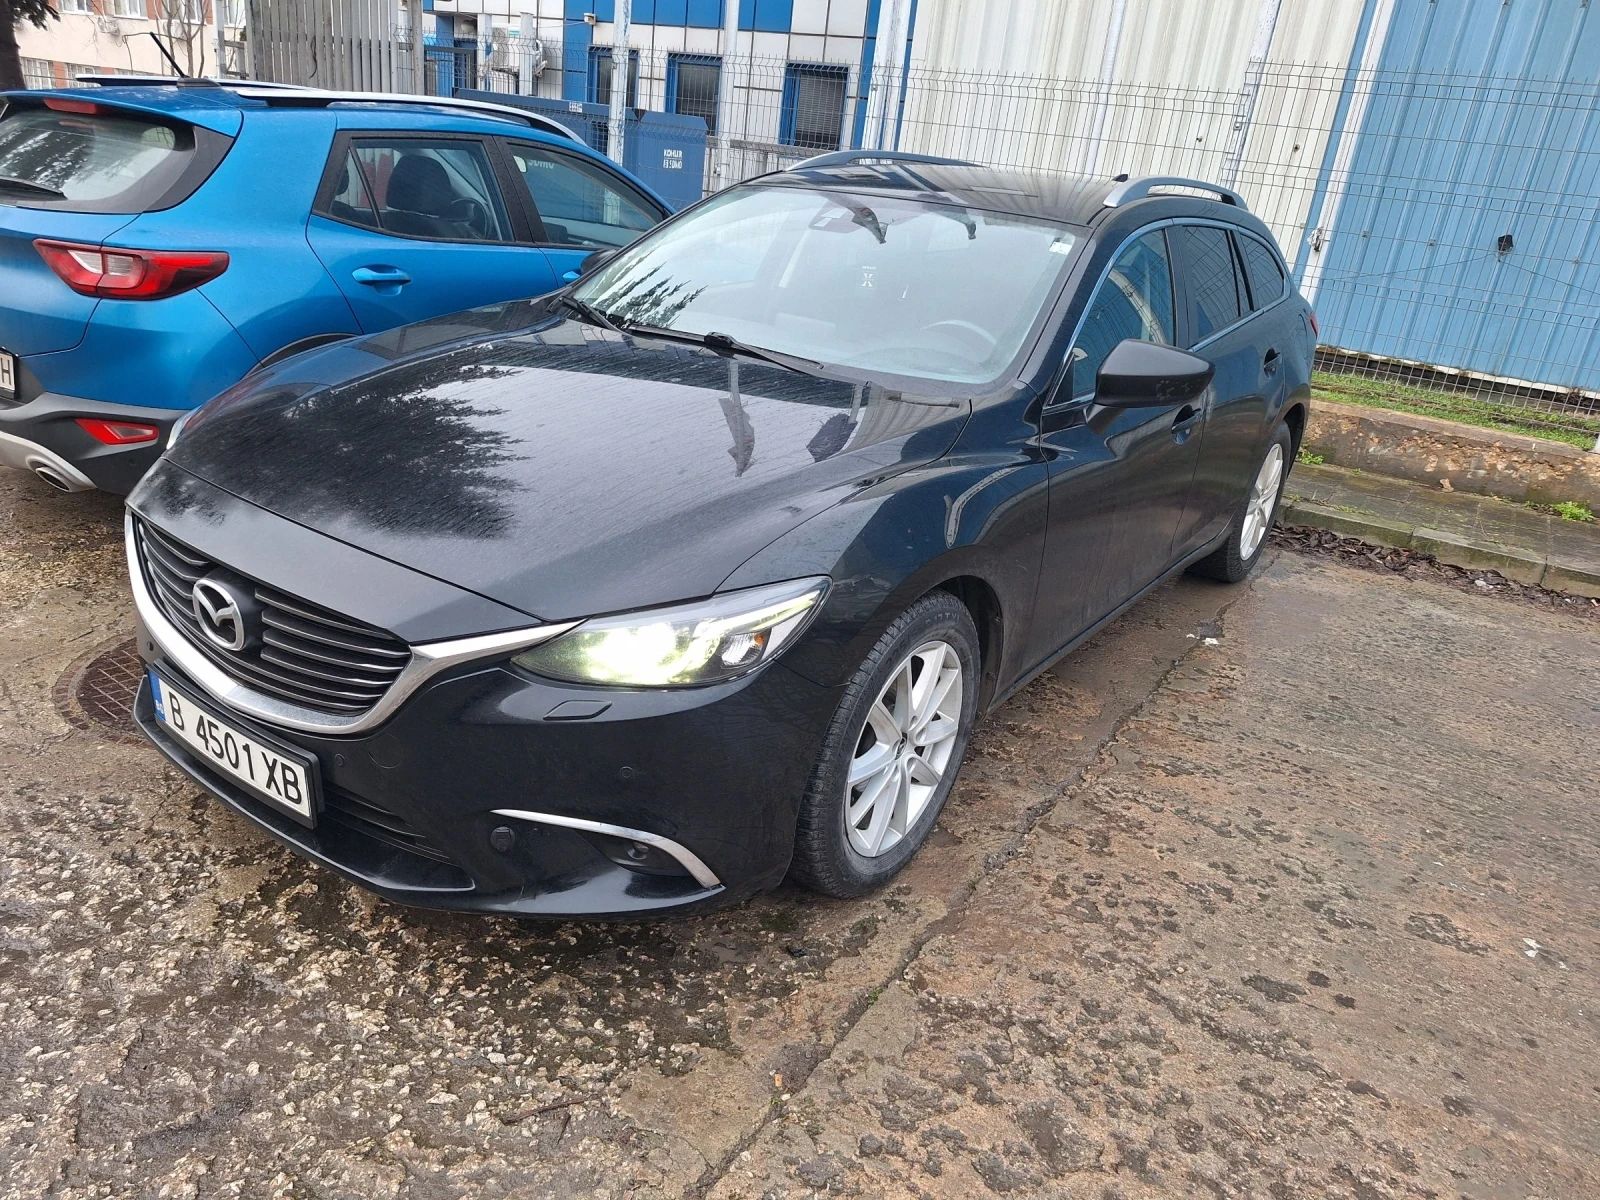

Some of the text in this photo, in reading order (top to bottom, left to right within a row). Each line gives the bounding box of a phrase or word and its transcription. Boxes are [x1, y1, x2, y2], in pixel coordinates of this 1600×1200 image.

[168, 691, 302, 805] B 4501 XB
